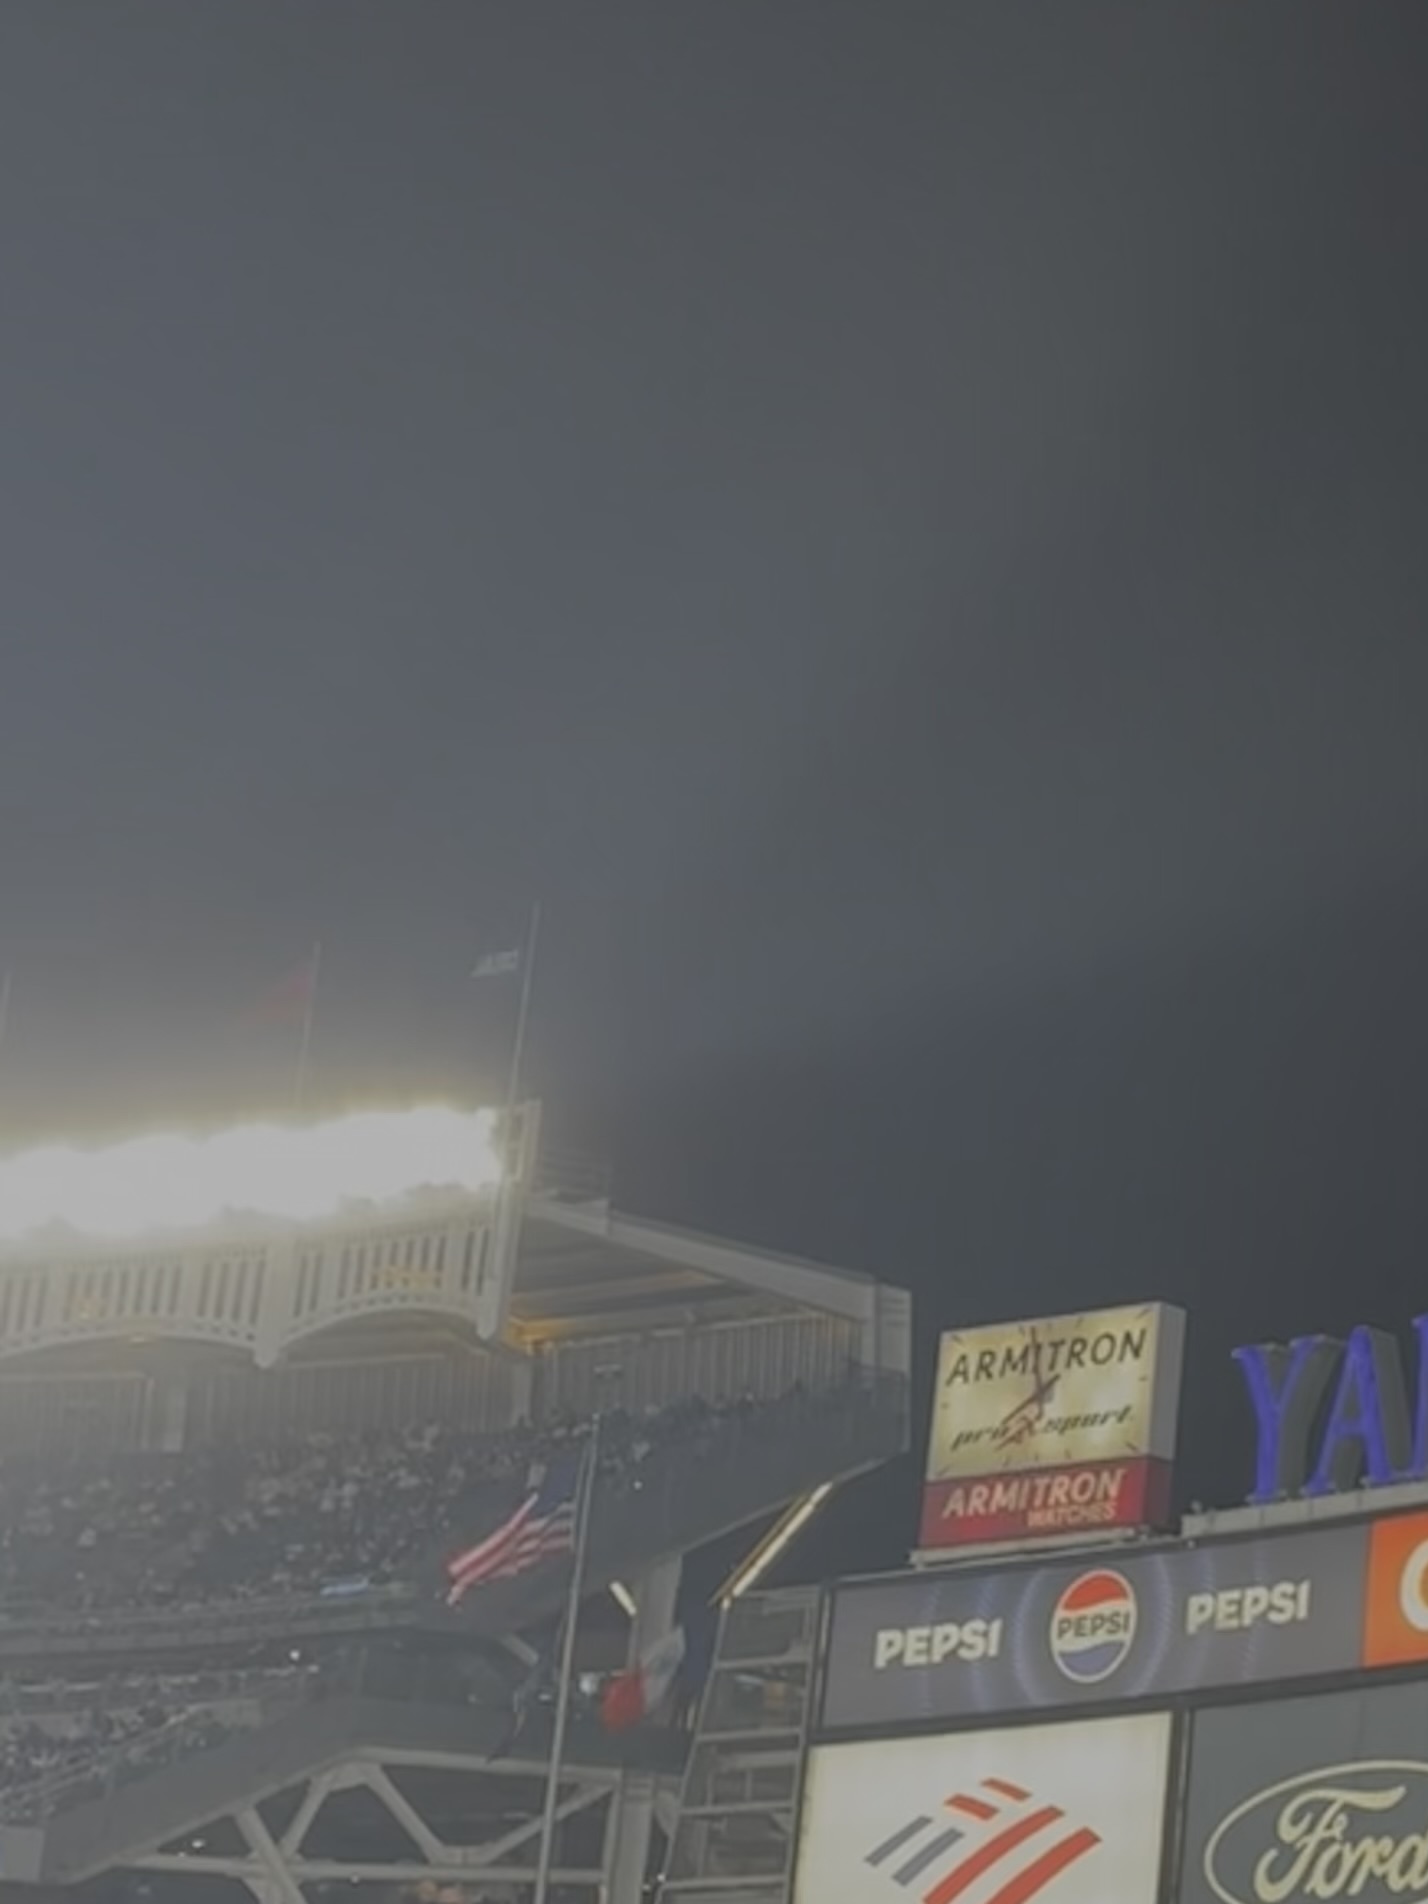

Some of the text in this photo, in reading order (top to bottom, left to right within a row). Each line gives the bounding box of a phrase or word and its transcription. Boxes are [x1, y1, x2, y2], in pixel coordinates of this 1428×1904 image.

[945, 1328, 1147, 1387] ARMITRON
[941, 1468, 1127, 1519] ARMITRON
[1027, 1500, 1117, 1527] WATCHES
[1057, 1611, 1132, 1640] PEPSI
[1186, 1581, 1310, 1634] PEPSI
[874, 1619, 1003, 1669] PEPSI
